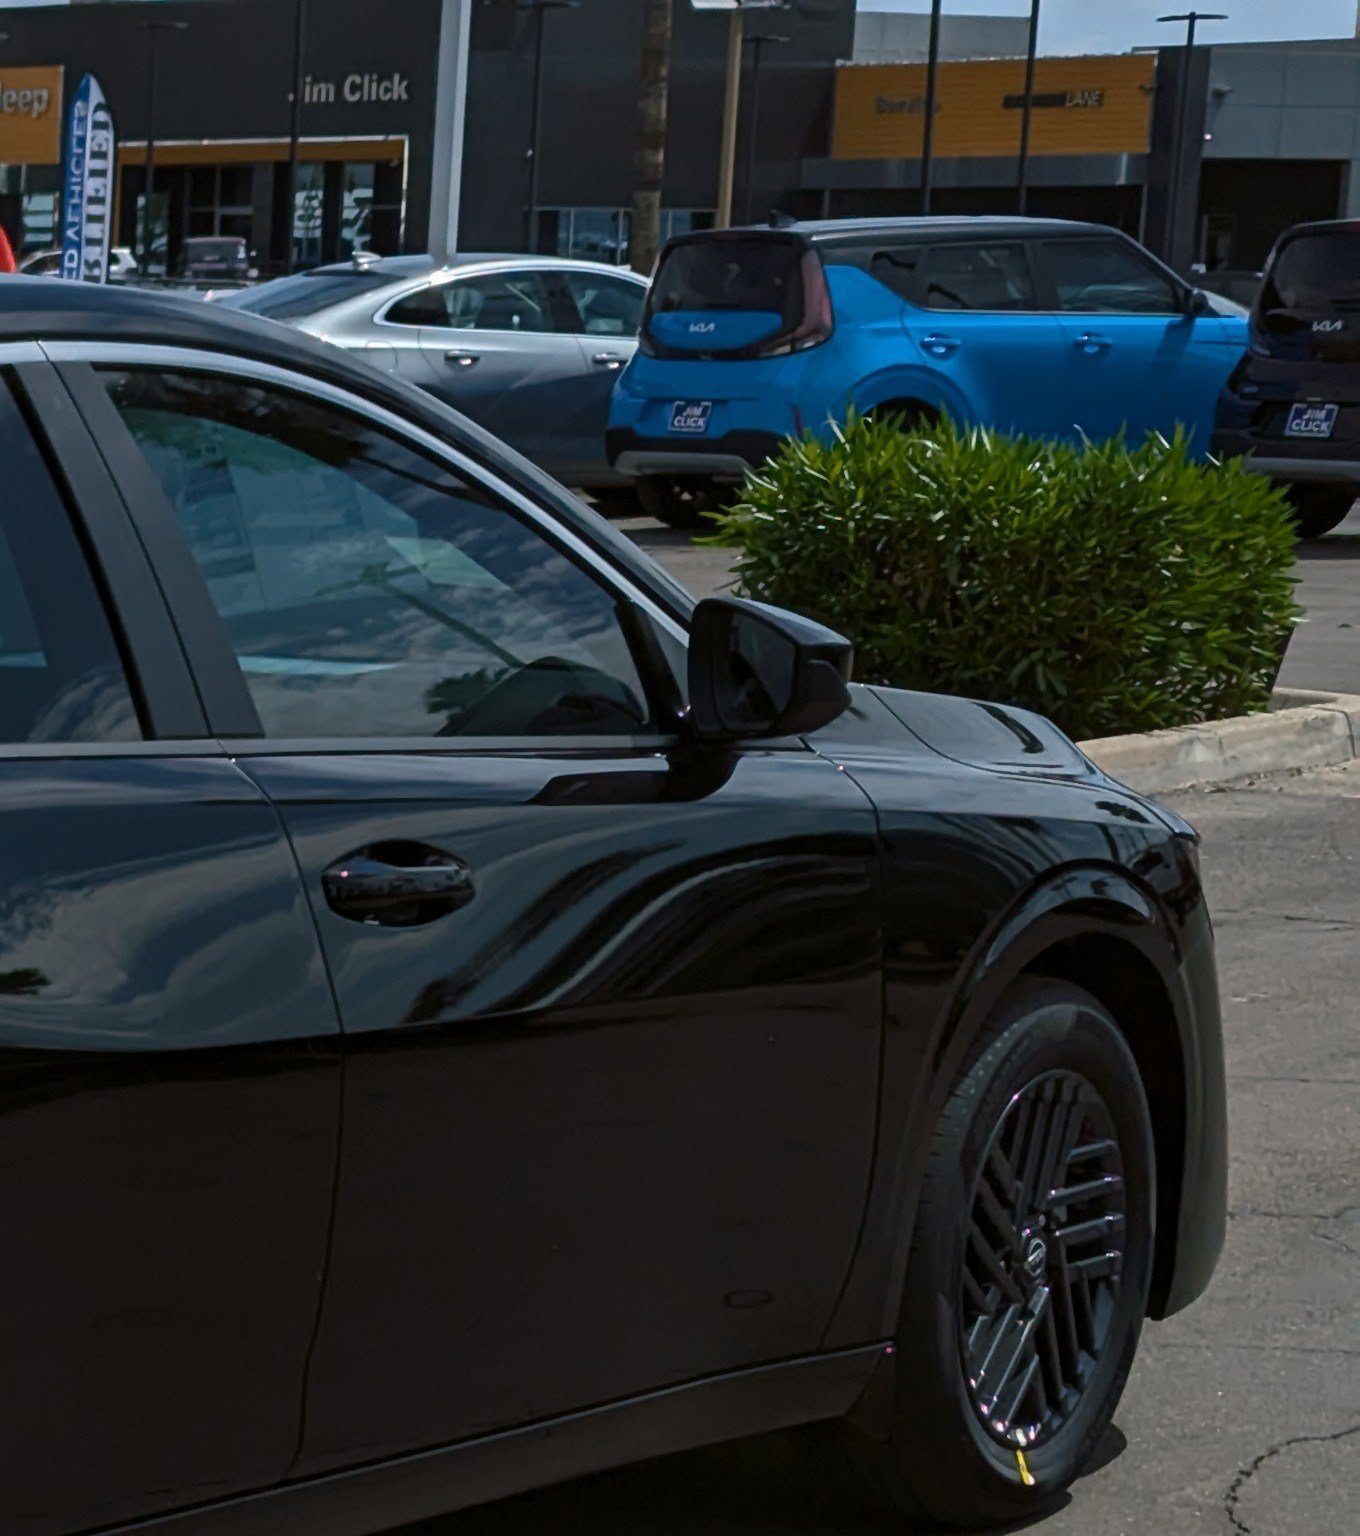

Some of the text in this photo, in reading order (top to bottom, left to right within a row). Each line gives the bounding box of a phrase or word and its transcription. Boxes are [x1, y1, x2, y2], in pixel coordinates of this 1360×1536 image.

[287, 72, 409, 103] im Click
[1291, 419, 1331, 432] CLICK
